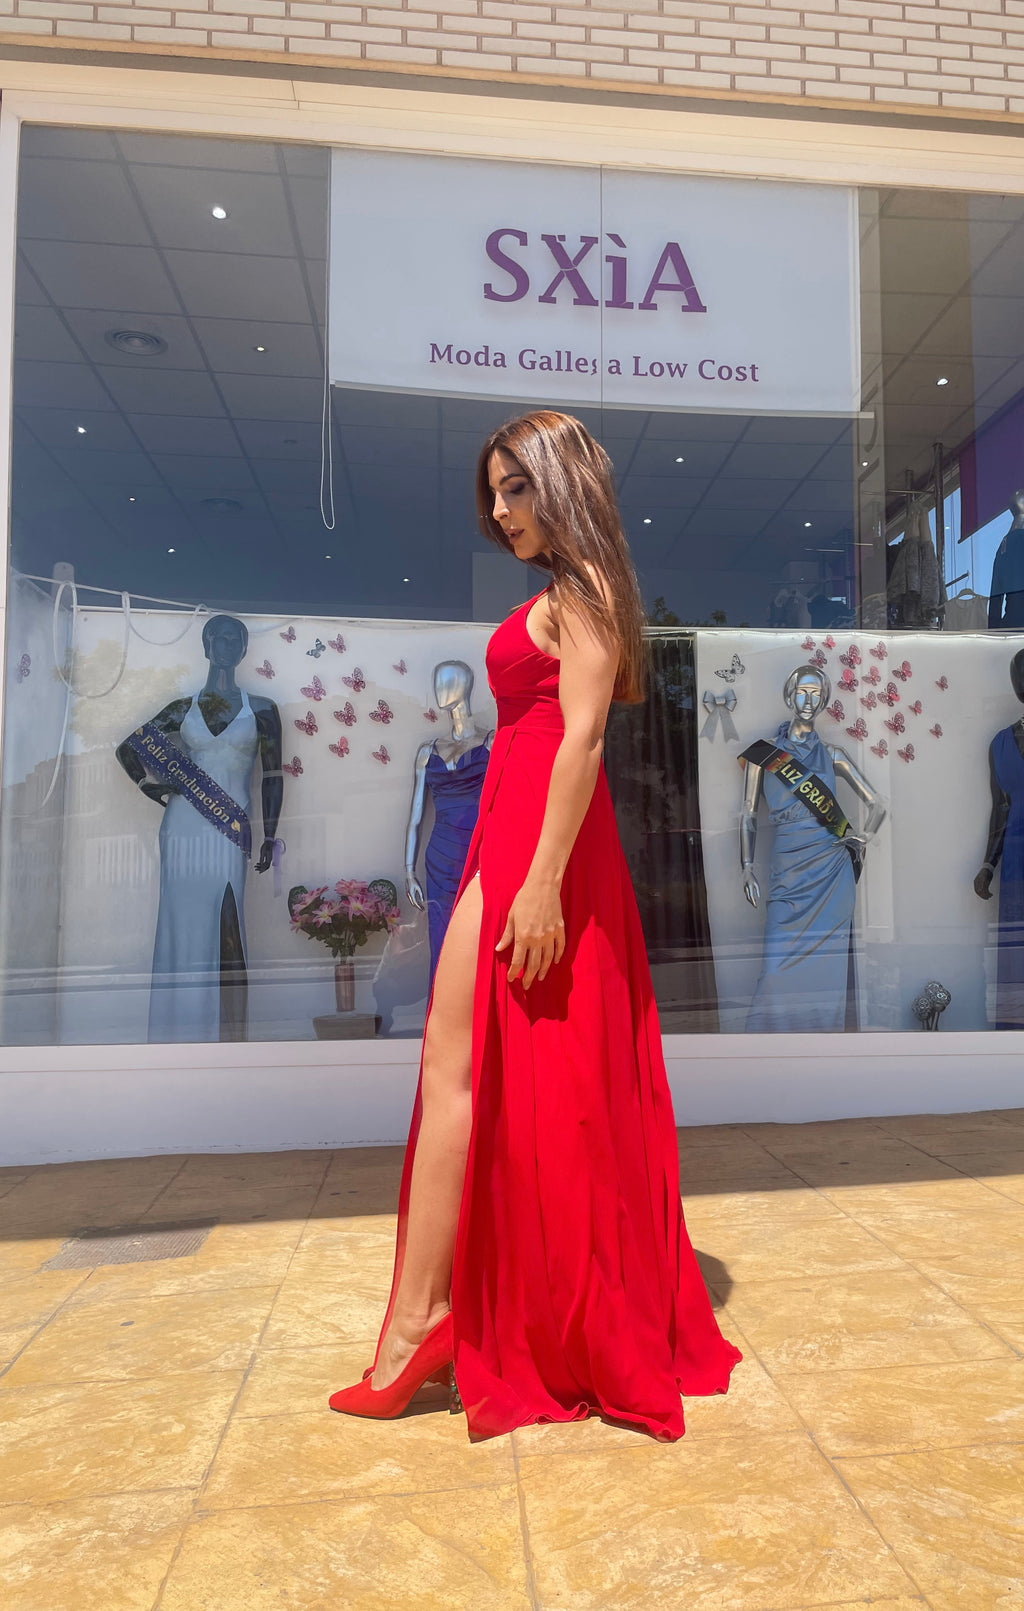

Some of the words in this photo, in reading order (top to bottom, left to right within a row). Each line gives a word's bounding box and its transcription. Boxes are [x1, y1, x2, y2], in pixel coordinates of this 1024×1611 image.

[429, 343, 507, 369] Moda
[632, 355, 688, 378] Low
[697, 358, 759, 383] Cost
[140, 735, 168, 764] Feliz
[166, 760, 230, 823] Graduación
